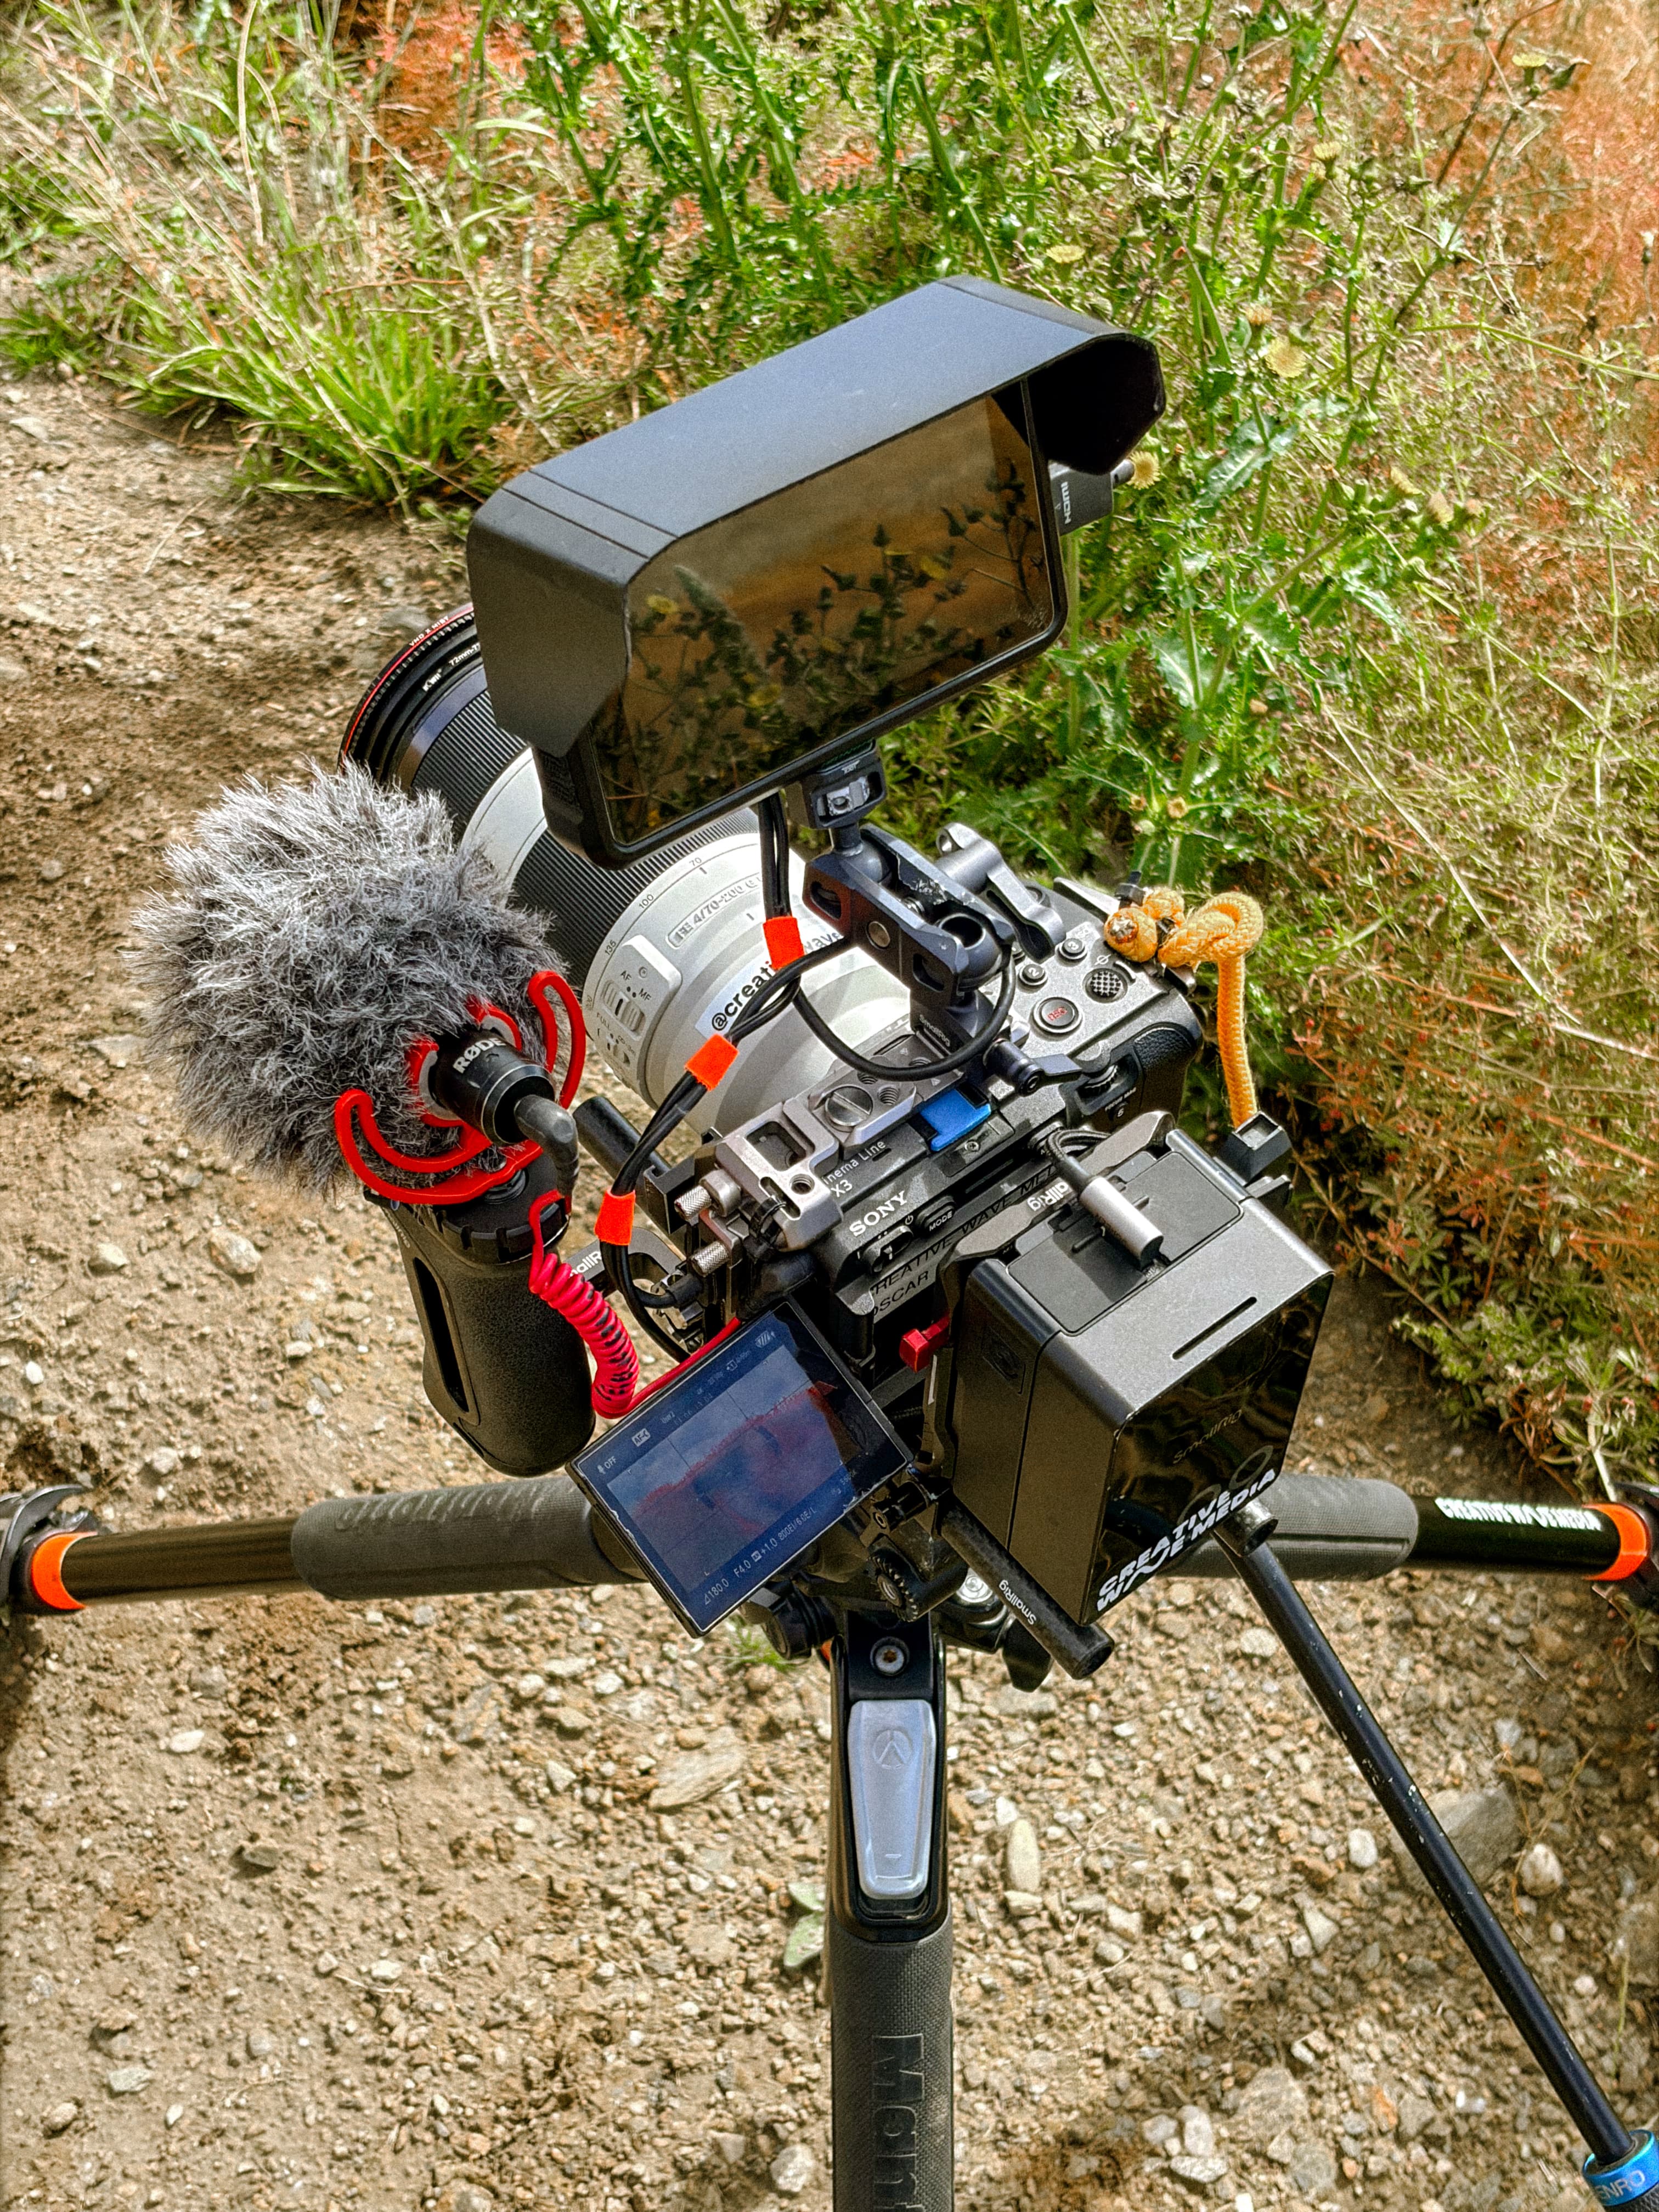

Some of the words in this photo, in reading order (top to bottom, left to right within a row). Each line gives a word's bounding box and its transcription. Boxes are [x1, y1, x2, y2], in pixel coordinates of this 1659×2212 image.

[689, 856, 703, 867] 70
[638, 893, 655, 910] 100
[604, 939, 617, 956] 135
[1067, 940, 1079, 951] 3
[620, 969, 633, 982] AF
[1028, 967, 1040, 977] 2
[638, 988, 652, 1003] MF
[919, 1013, 951, 1048] SmallRig
[823, 1156, 859, 1186] inema
[863, 1140, 887, 1163] Line
[830, 1182, 854, 1199] X3
[1026, 1181, 1069, 1212] allRig
[849, 1190, 909, 1237] SONY
[928, 1210, 953, 1232] MODE
[870, 1236, 953, 1296] REATIVE
[1172, 1409, 1243, 1464] SmallRig
[604, 1455, 617, 1470] OFF
[1190, 1468, 1277, 1540] MEDIA
[733, 1559, 752, 1578] F4.0
[760, 1537, 778, 1555] +1.0
[1098, 1490, 1231, 1597] CREATIVE
[998, 1579, 1037, 1626] SmallRig
[1594, 2169, 1645, 2199] ENRO
